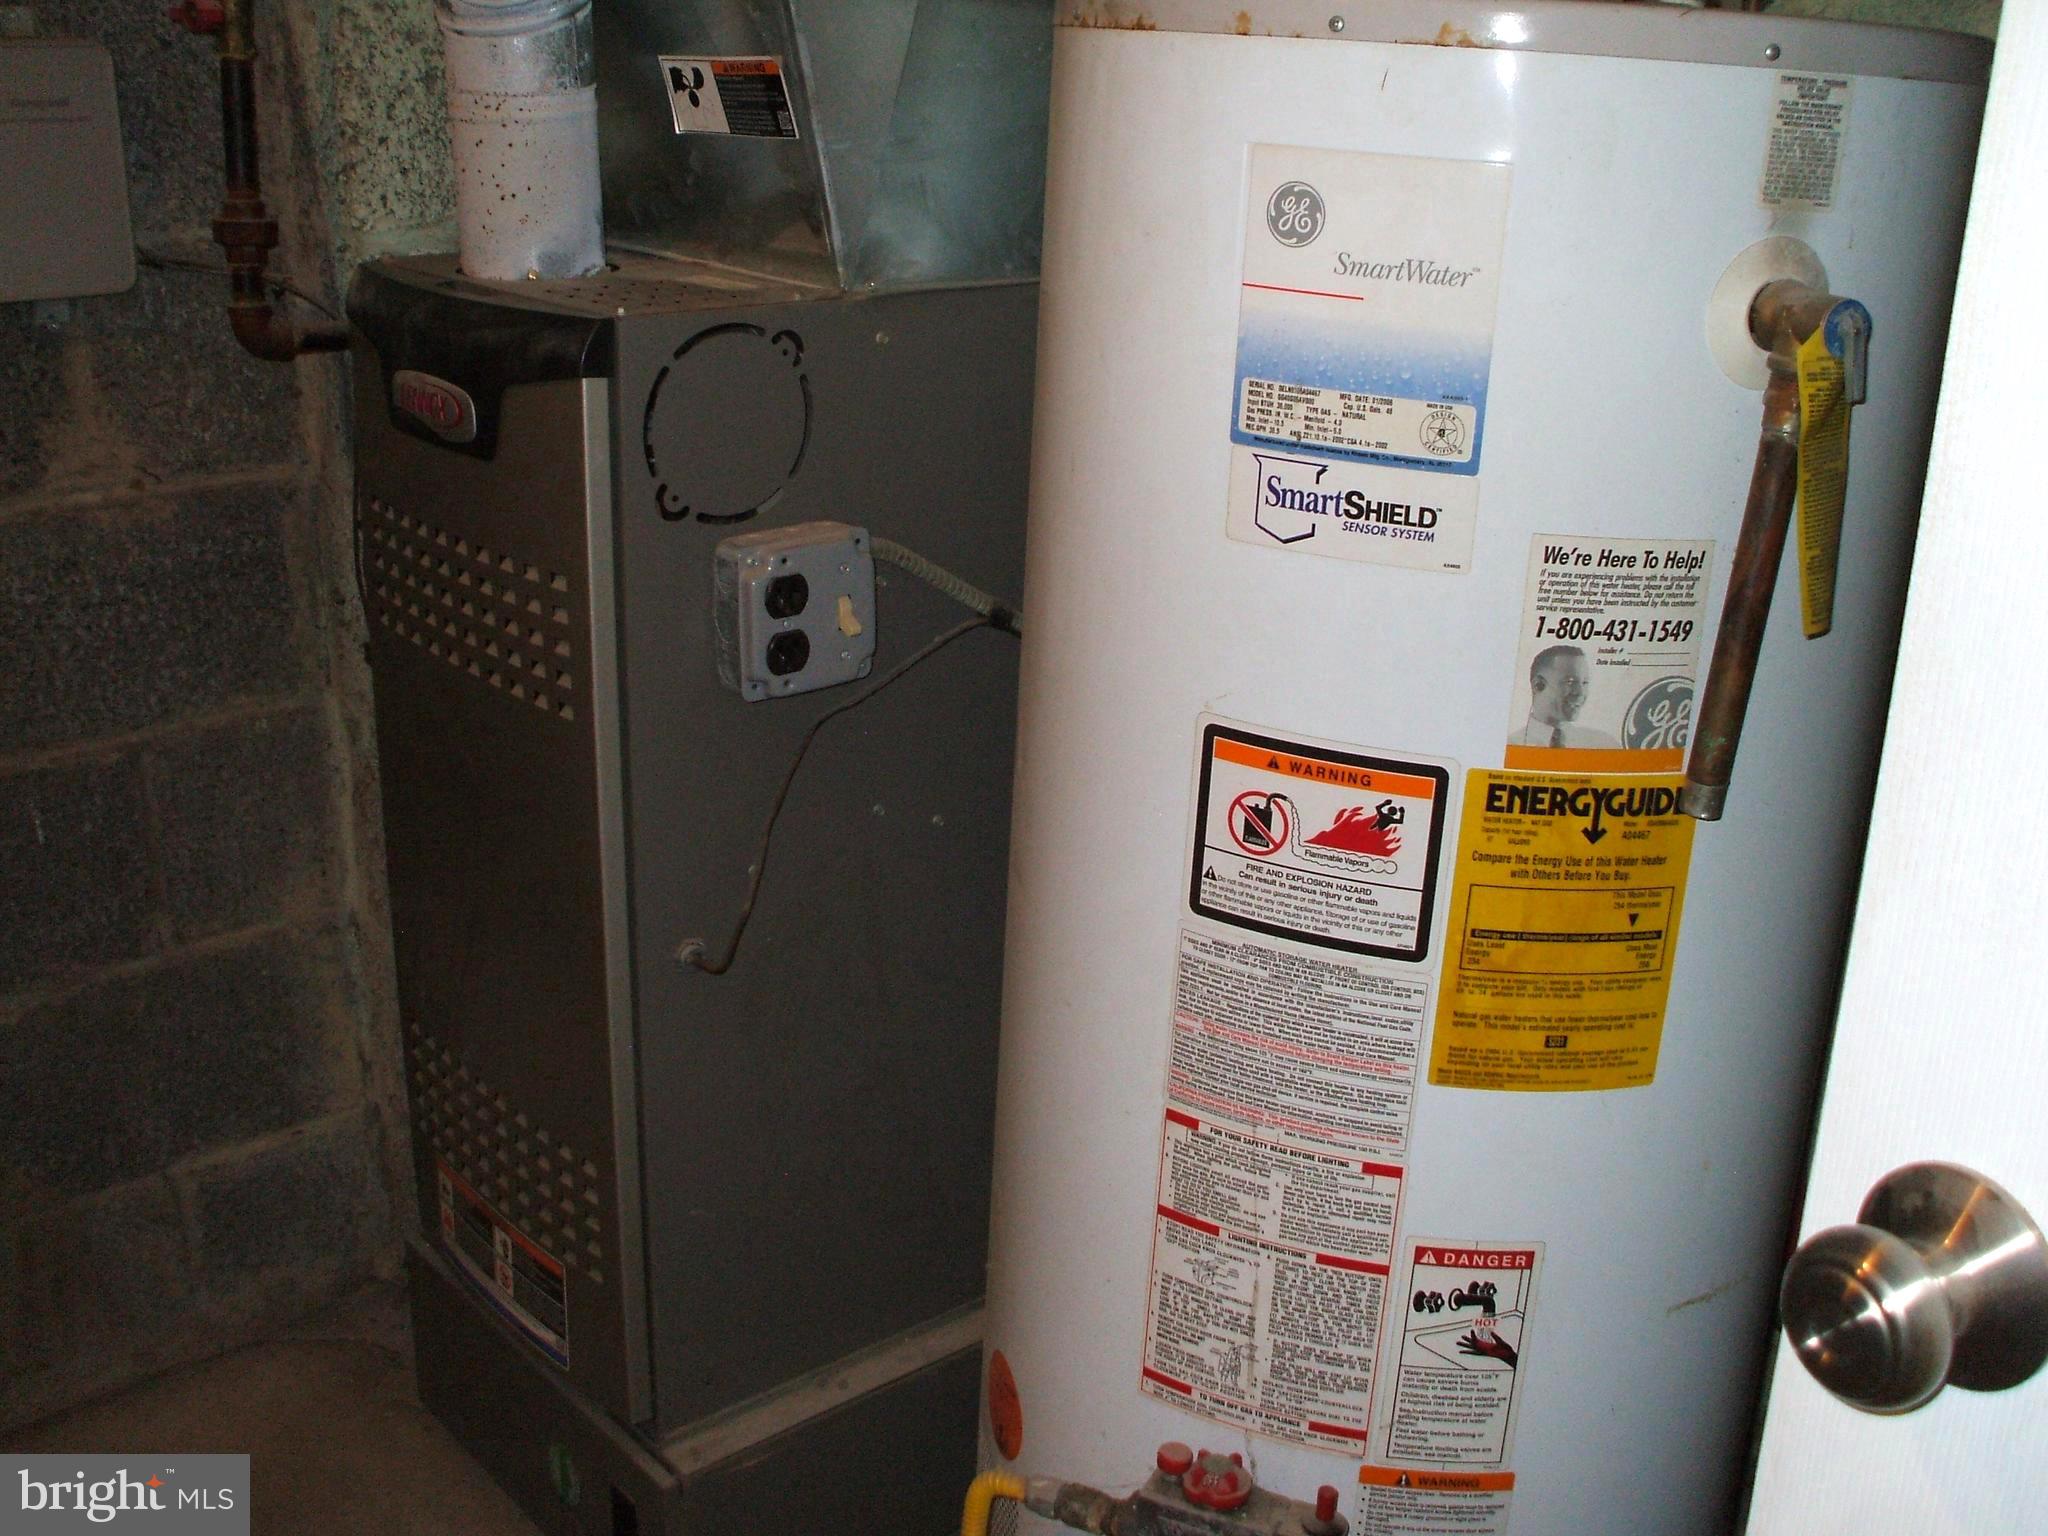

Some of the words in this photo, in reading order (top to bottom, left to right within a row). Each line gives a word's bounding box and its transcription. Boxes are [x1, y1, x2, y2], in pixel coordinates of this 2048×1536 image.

[1249, 380, 1265, 389] SERIAL
[1306, 406, 1318, 414] TYPE
[1321, 408, 1331, 416] GAS
[1342, 411, 1366, 420] NATURAL
[1342, 521, 1386, 537] SENSOR
[1391, 526, 1435, 543] SYSTEM
[1543, 546, 1592, 566] We're
[1597, 549, 1636, 567] Here
[1643, 551, 1659, 569] To
[1664, 550, 1706, 573] Help!
[1547, 571, 1560, 579] you
[1574, 573, 1613, 582] experiencing
[1615, 573, 1643, 582] problems
[1670, 574, 1700, 582] installation
[1548, 580, 1579, 588] operation
[1643, 583, 1661, 591] please
[1580, 589, 1599, 597] below
[1536, 616, 1693, 642] 1-800-431-1549
[1290, 760, 1373, 787] WARNING
[1304, 849, 1343, 866] Flammable
[1344, 855, 1369, 868] Vapors
[1472, 851, 1511, 864] Compare
[1515, 854, 1529, 864] the
[1533, 854, 1563, 868] Energy
[1566, 856, 1581, 867] Use
[1585, 856, 1593, 867] of
[1596, 856, 1611, 867] this
[1615, 856, 1639, 866] Water
[1641, 855, 1667, 865] Heater
[1246, 863, 1263, 873] FIRE
[1266, 869, 1283, 878] AND
[1286, 873, 1334, 888] EXPLOSION
[1336, 883, 1372, 896] HAZARD
[1511, 869, 1529, 880] with
[1532, 869, 1560, 880] Others
[1564, 870, 1591, 881] Before
[1595, 870, 1610, 881] You
[1239, 870, 1253, 880] Can
[1255, 876, 1277, 886] result
[1288, 884, 1317, 896] serious
[1320, 890, 1342, 901] injury
[1355, 895, 1378, 906] death
[1219, 885, 1236, 896] vicinity
[1276, 900, 1292, 908] other
[1325, 911, 1350, 921] Storage
[1388, 922, 1416, 931] gasoline
[1238, 881, 1252, 889] store
[1273, 890, 1298, 900] gasoline
[1325, 901, 1359, 912] flammable
[1359, 907, 1380, 917] vapors
[1382, 911, 1395, 919] and
[1396, 912, 1417, 921] liquids
[1201, 897, 1227, 908] appliance
[1240, 908, 1255, 916] result
[1264, 914, 1285, 924] serious
[1287, 920, 1303, 929] injury
[1242, 943, 1278, 958] AUTOMATIC
[1278, 951, 1308, 963] STORAGE
[1309, 959, 1330, 968] WATER
[1332, 963, 1358, 973] HEATER
[1210, 1127, 1222, 1136] FOR
[1224, 1132, 1241, 1141] YOUR
[1243, 1136, 1268, 1149] SAFETY
[1270, 1144, 1288, 1155] READ
[1290, 1147, 1317, 1160] BEFORE
[1318, 1156, 1350, 1168] LIGHTING
[1228, 1233, 1258, 1248] LIGHTING
[1259, 1242, 1307, 1259] INSTRUCTIONS
[1443, 1251, 1527, 1268] DANGER
[1474, 1317, 1499, 1327] HOT
[1424, 1371, 1463, 1379] temperature
[1209, 1395, 1225, 1406] TURN
[1227, 1400, 1238, 1410] OFF
[1240, 1405, 1253, 1415] GAS
[1255, 1410, 1263, 1418] TO
[1265, 1413, 1300, 1427] APPLIANCE
[1418, 1477, 1480, 1488] WARNING
